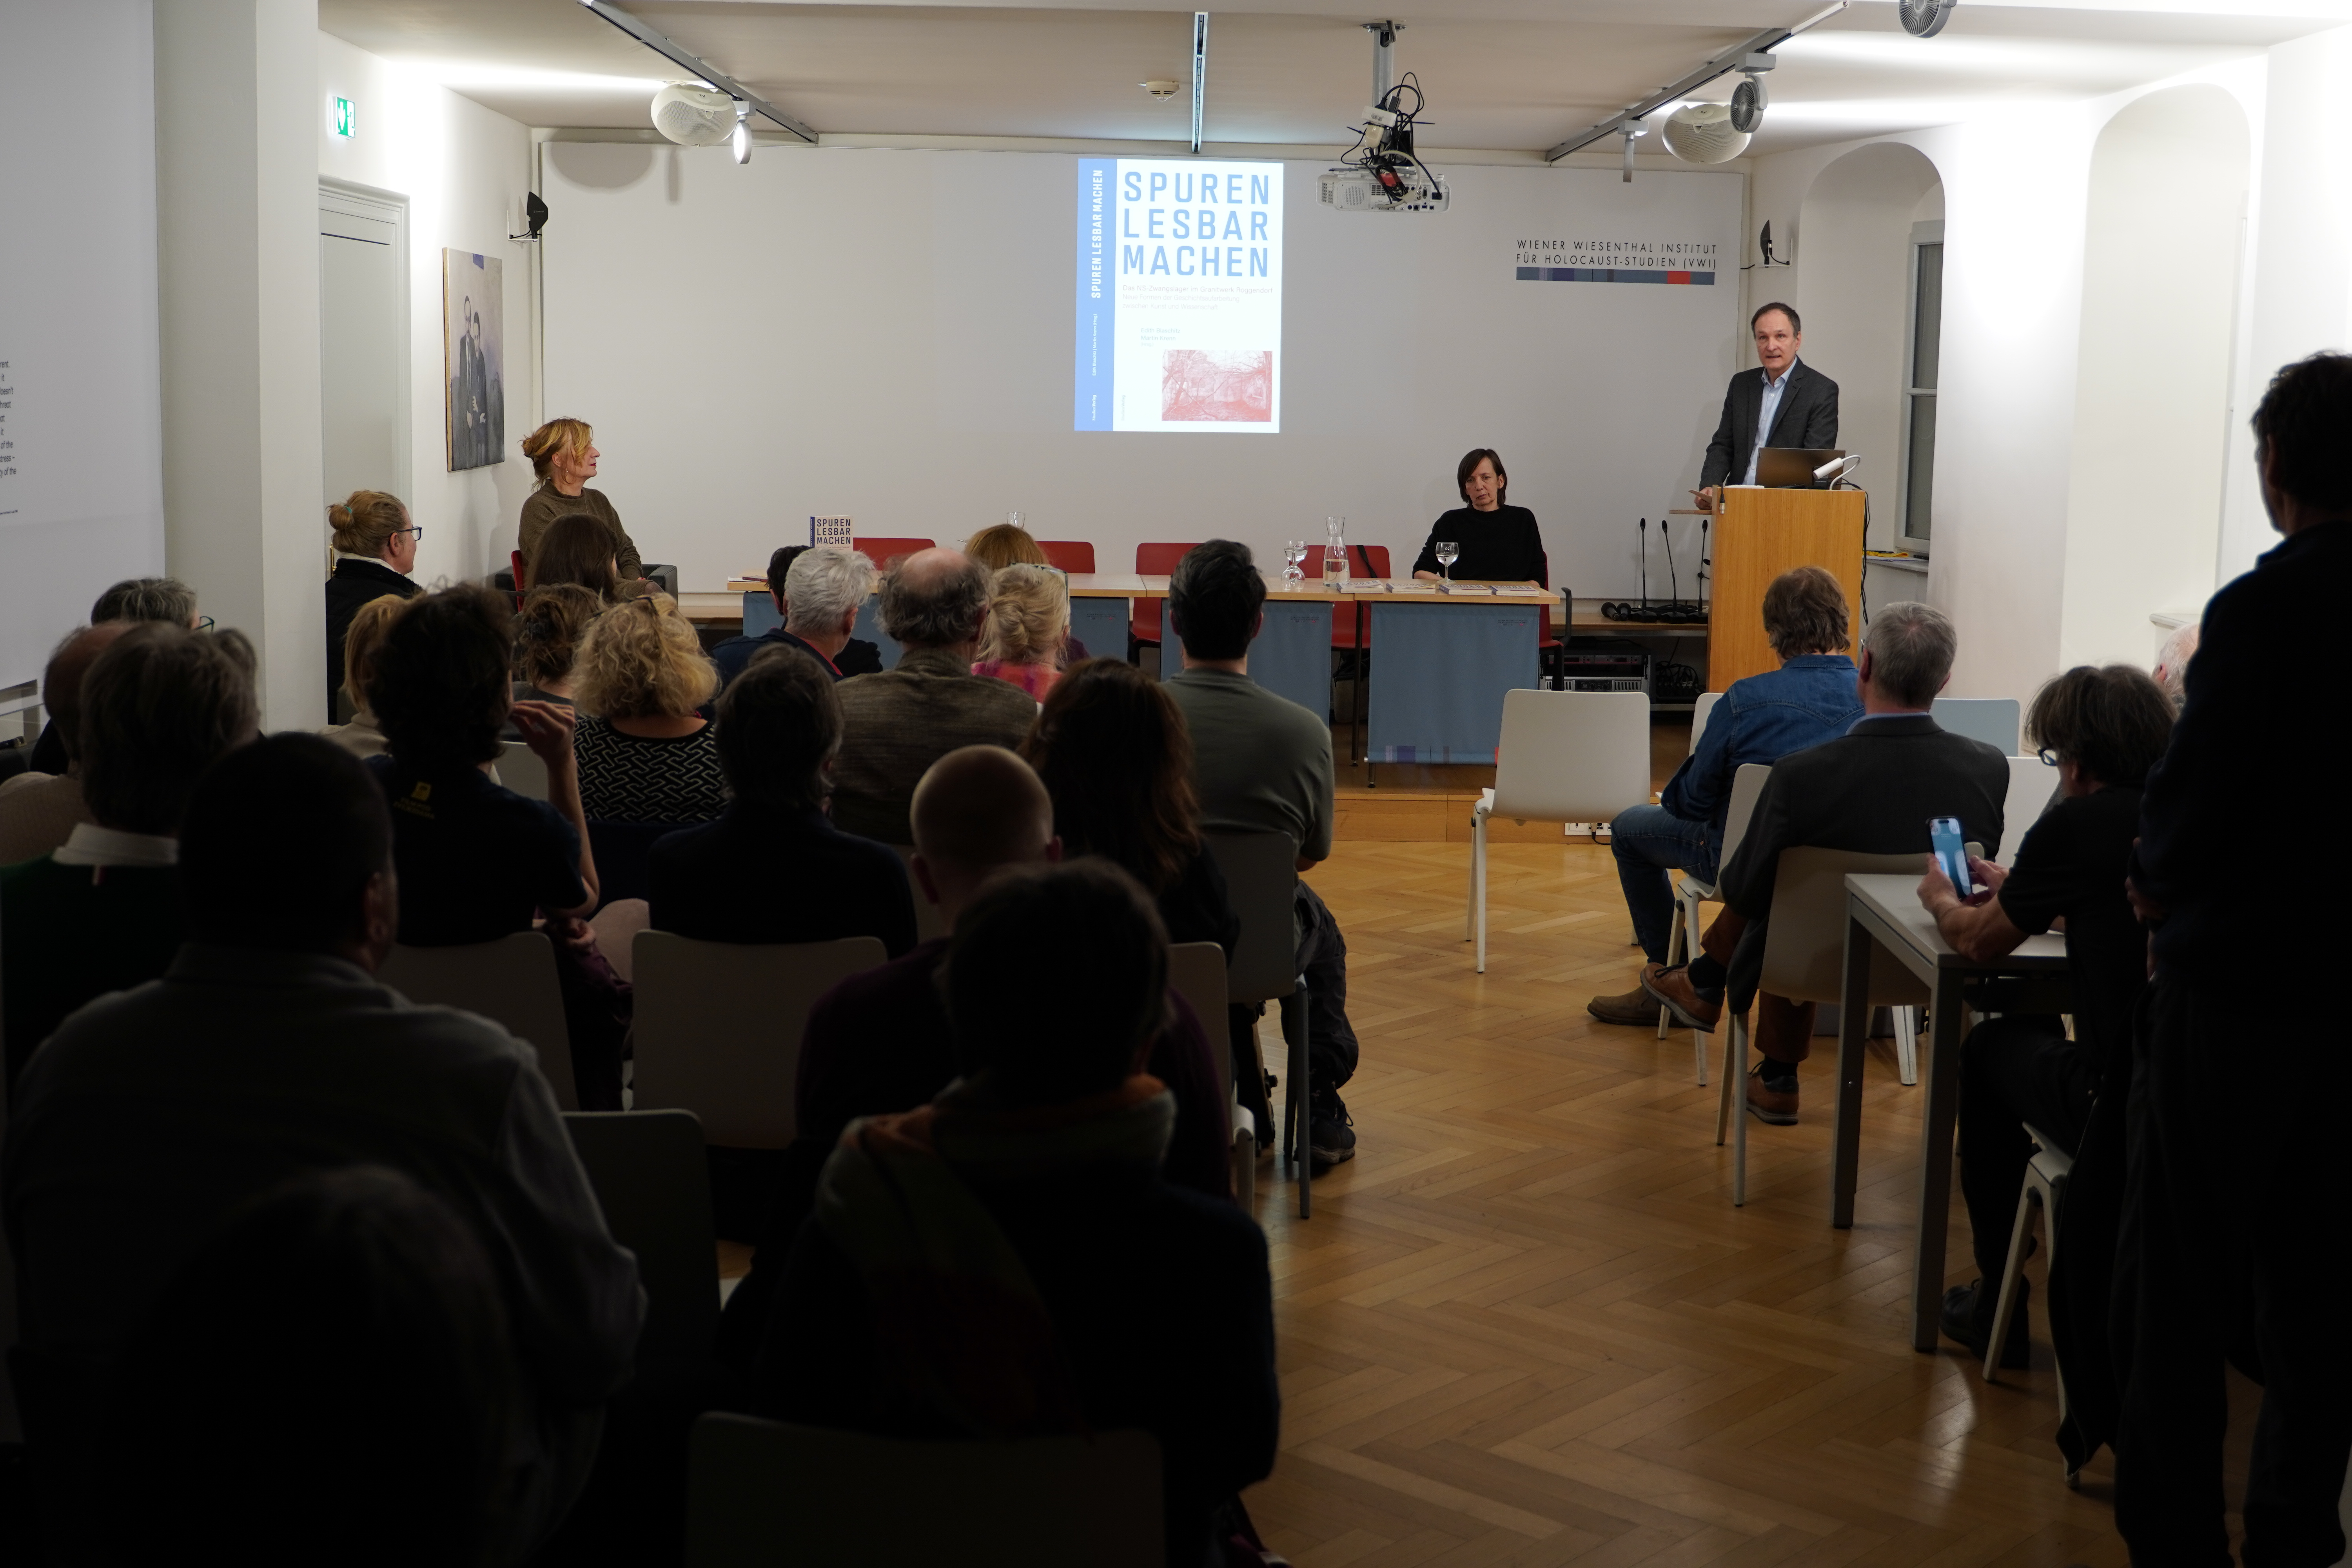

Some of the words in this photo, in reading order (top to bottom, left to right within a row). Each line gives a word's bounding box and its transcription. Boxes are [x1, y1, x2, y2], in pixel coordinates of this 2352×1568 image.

[1093, 170, 1103, 212] MACHEN
[1124, 171, 1269, 205] SPUREN
[1092, 214, 1102, 255] LESBAR
[1123, 208, 1268, 241] LESBAR
[1517, 240, 1565, 250] WIENER
[1573, 241, 1653, 252] WIESENTHAL
[1661, 243, 1716, 254] INSTITUT
[1123, 245, 1268, 277] MACHEN
[1516, 252, 1536, 263] FÜR
[1545, 255, 1675, 267] HOLOCAUST-STUDIEN
[1684, 258, 1716, 270] (VWI)
[1091, 258, 1101, 298] SPUREN
[1137, 285, 1189, 293] NS-Zwangslager
[1174, 294, 1240, 303] Geschichtsaufarbeitung
[817, 519, 851, 527] SPUREN
[817, 536, 851, 544] MACHEN
